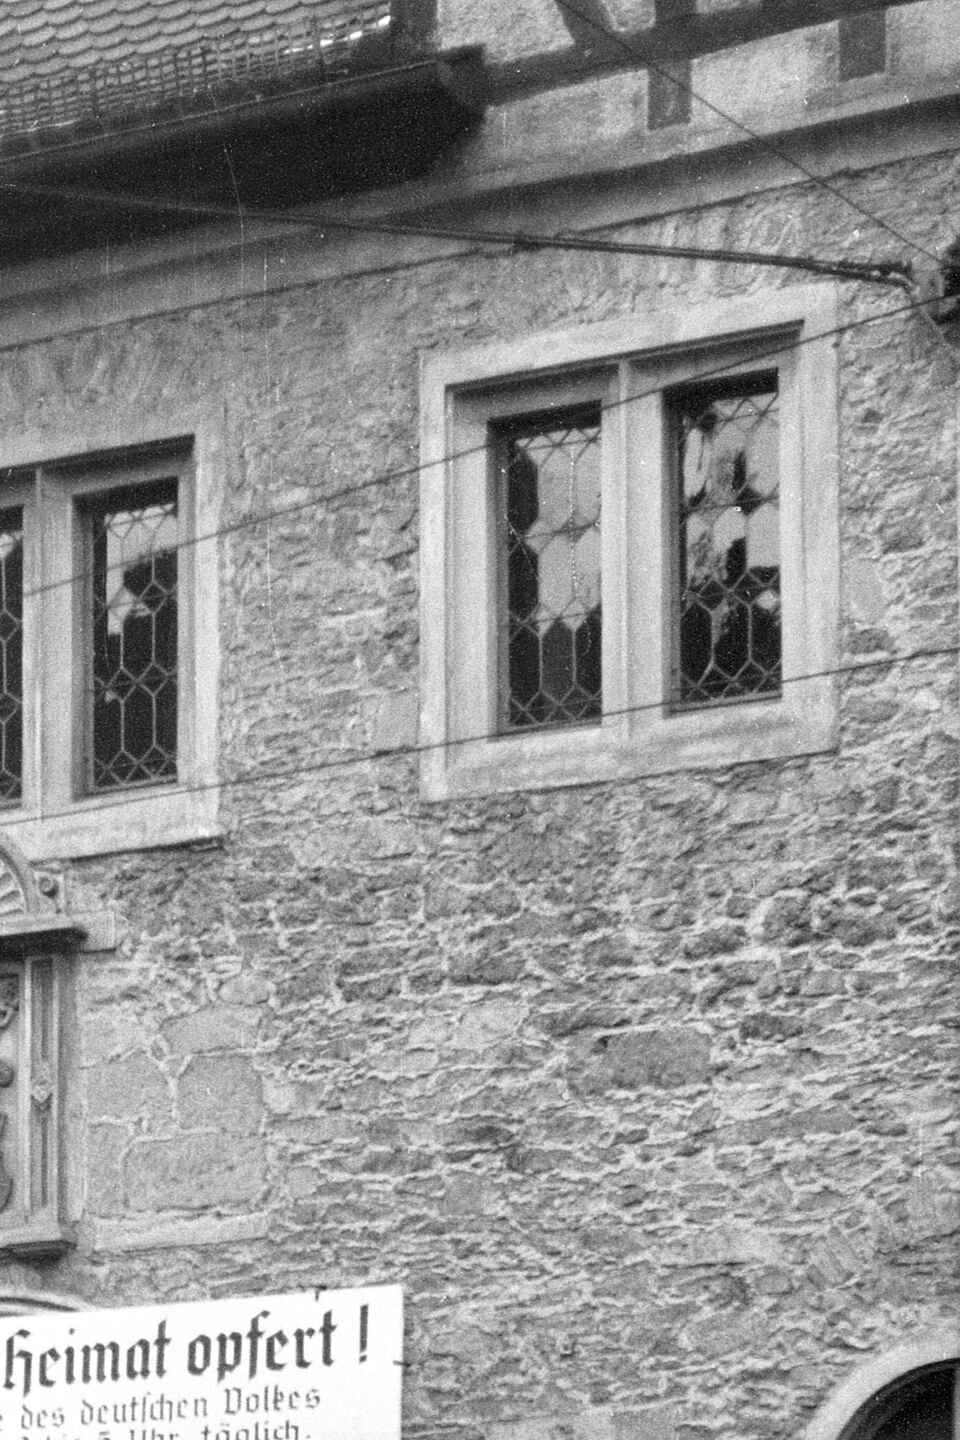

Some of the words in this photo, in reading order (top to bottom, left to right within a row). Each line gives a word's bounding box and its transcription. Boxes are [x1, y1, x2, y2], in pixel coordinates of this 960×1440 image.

[3, 1319, 172, 1398] Heimat
[20, 1405, 66, 1430] des
[224, 1385, 321, 1415] Volkes
